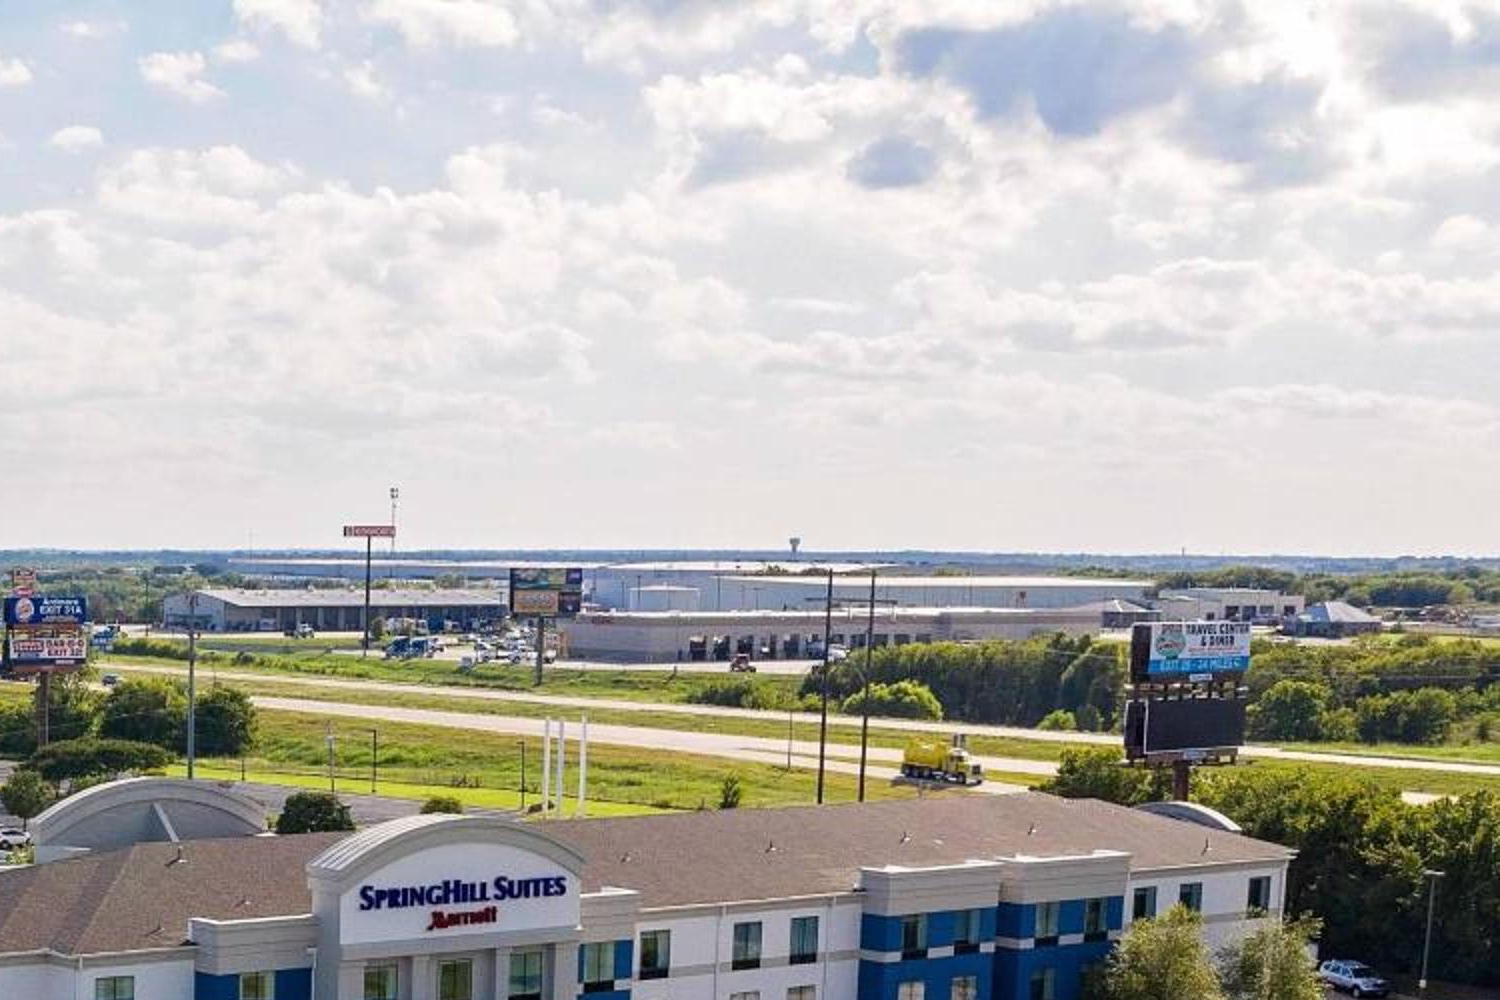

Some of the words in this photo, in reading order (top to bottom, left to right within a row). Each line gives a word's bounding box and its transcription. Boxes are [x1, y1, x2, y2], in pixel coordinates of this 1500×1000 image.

[40, 605, 61, 615] EXIT
[1187, 624, 1217, 635] TRAVEL
[1219, 624, 1250, 635] CENTER
[1209, 635, 1235, 646] DINER
[47, 649, 67, 657] EXIT
[426, 906, 498, 931] Marriott
